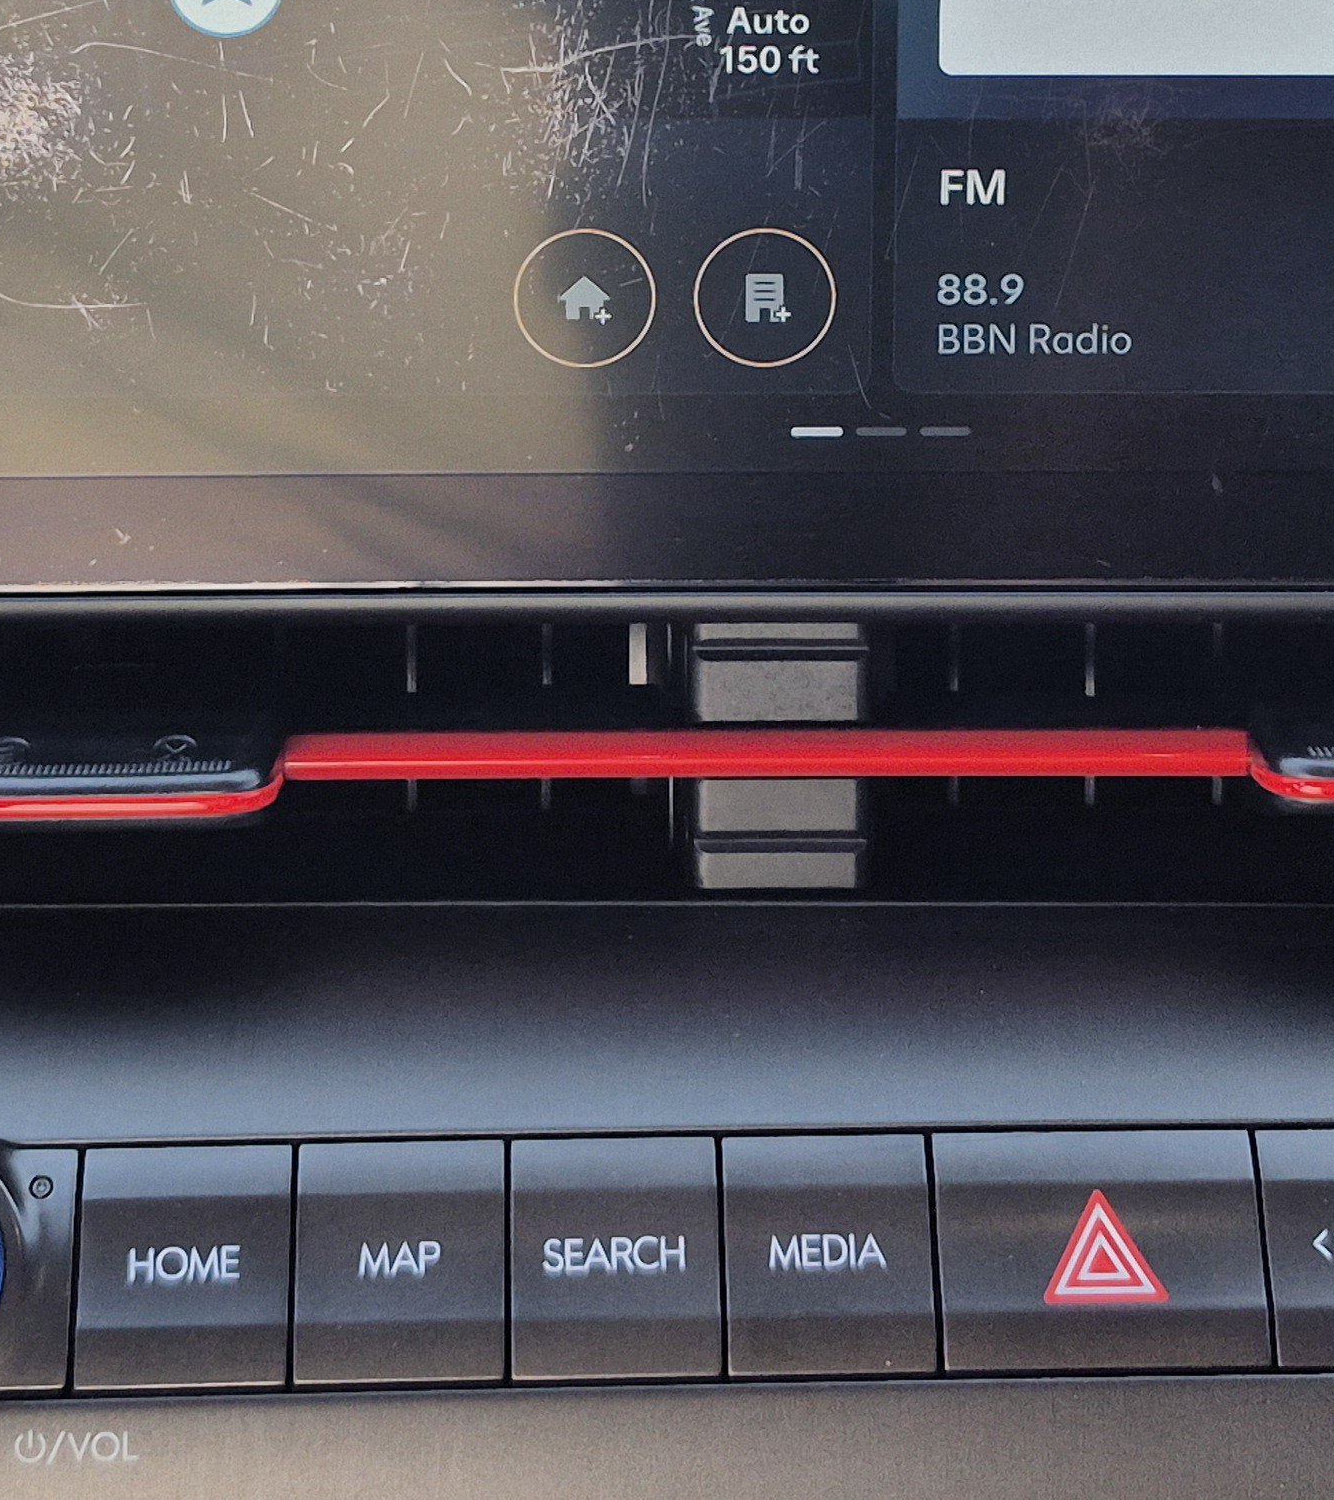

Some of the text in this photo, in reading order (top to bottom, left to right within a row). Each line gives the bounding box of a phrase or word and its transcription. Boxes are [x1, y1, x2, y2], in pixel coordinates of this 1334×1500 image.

[691, 5, 714, 47] Ave
[726, 6, 810, 35] Auto
[719, 44, 820, 75] 150 ft
[940, 169, 1005, 206] FM
[937, 274, 1024, 306] 88.9
[937, 323, 1133, 356] BBN Radio
[127, 1245, 241, 1285] HOME
[358, 1240, 442, 1278] MAP
[542, 1236, 687, 1276] SEARCH
[769, 1233, 887, 1272] MEDIA
